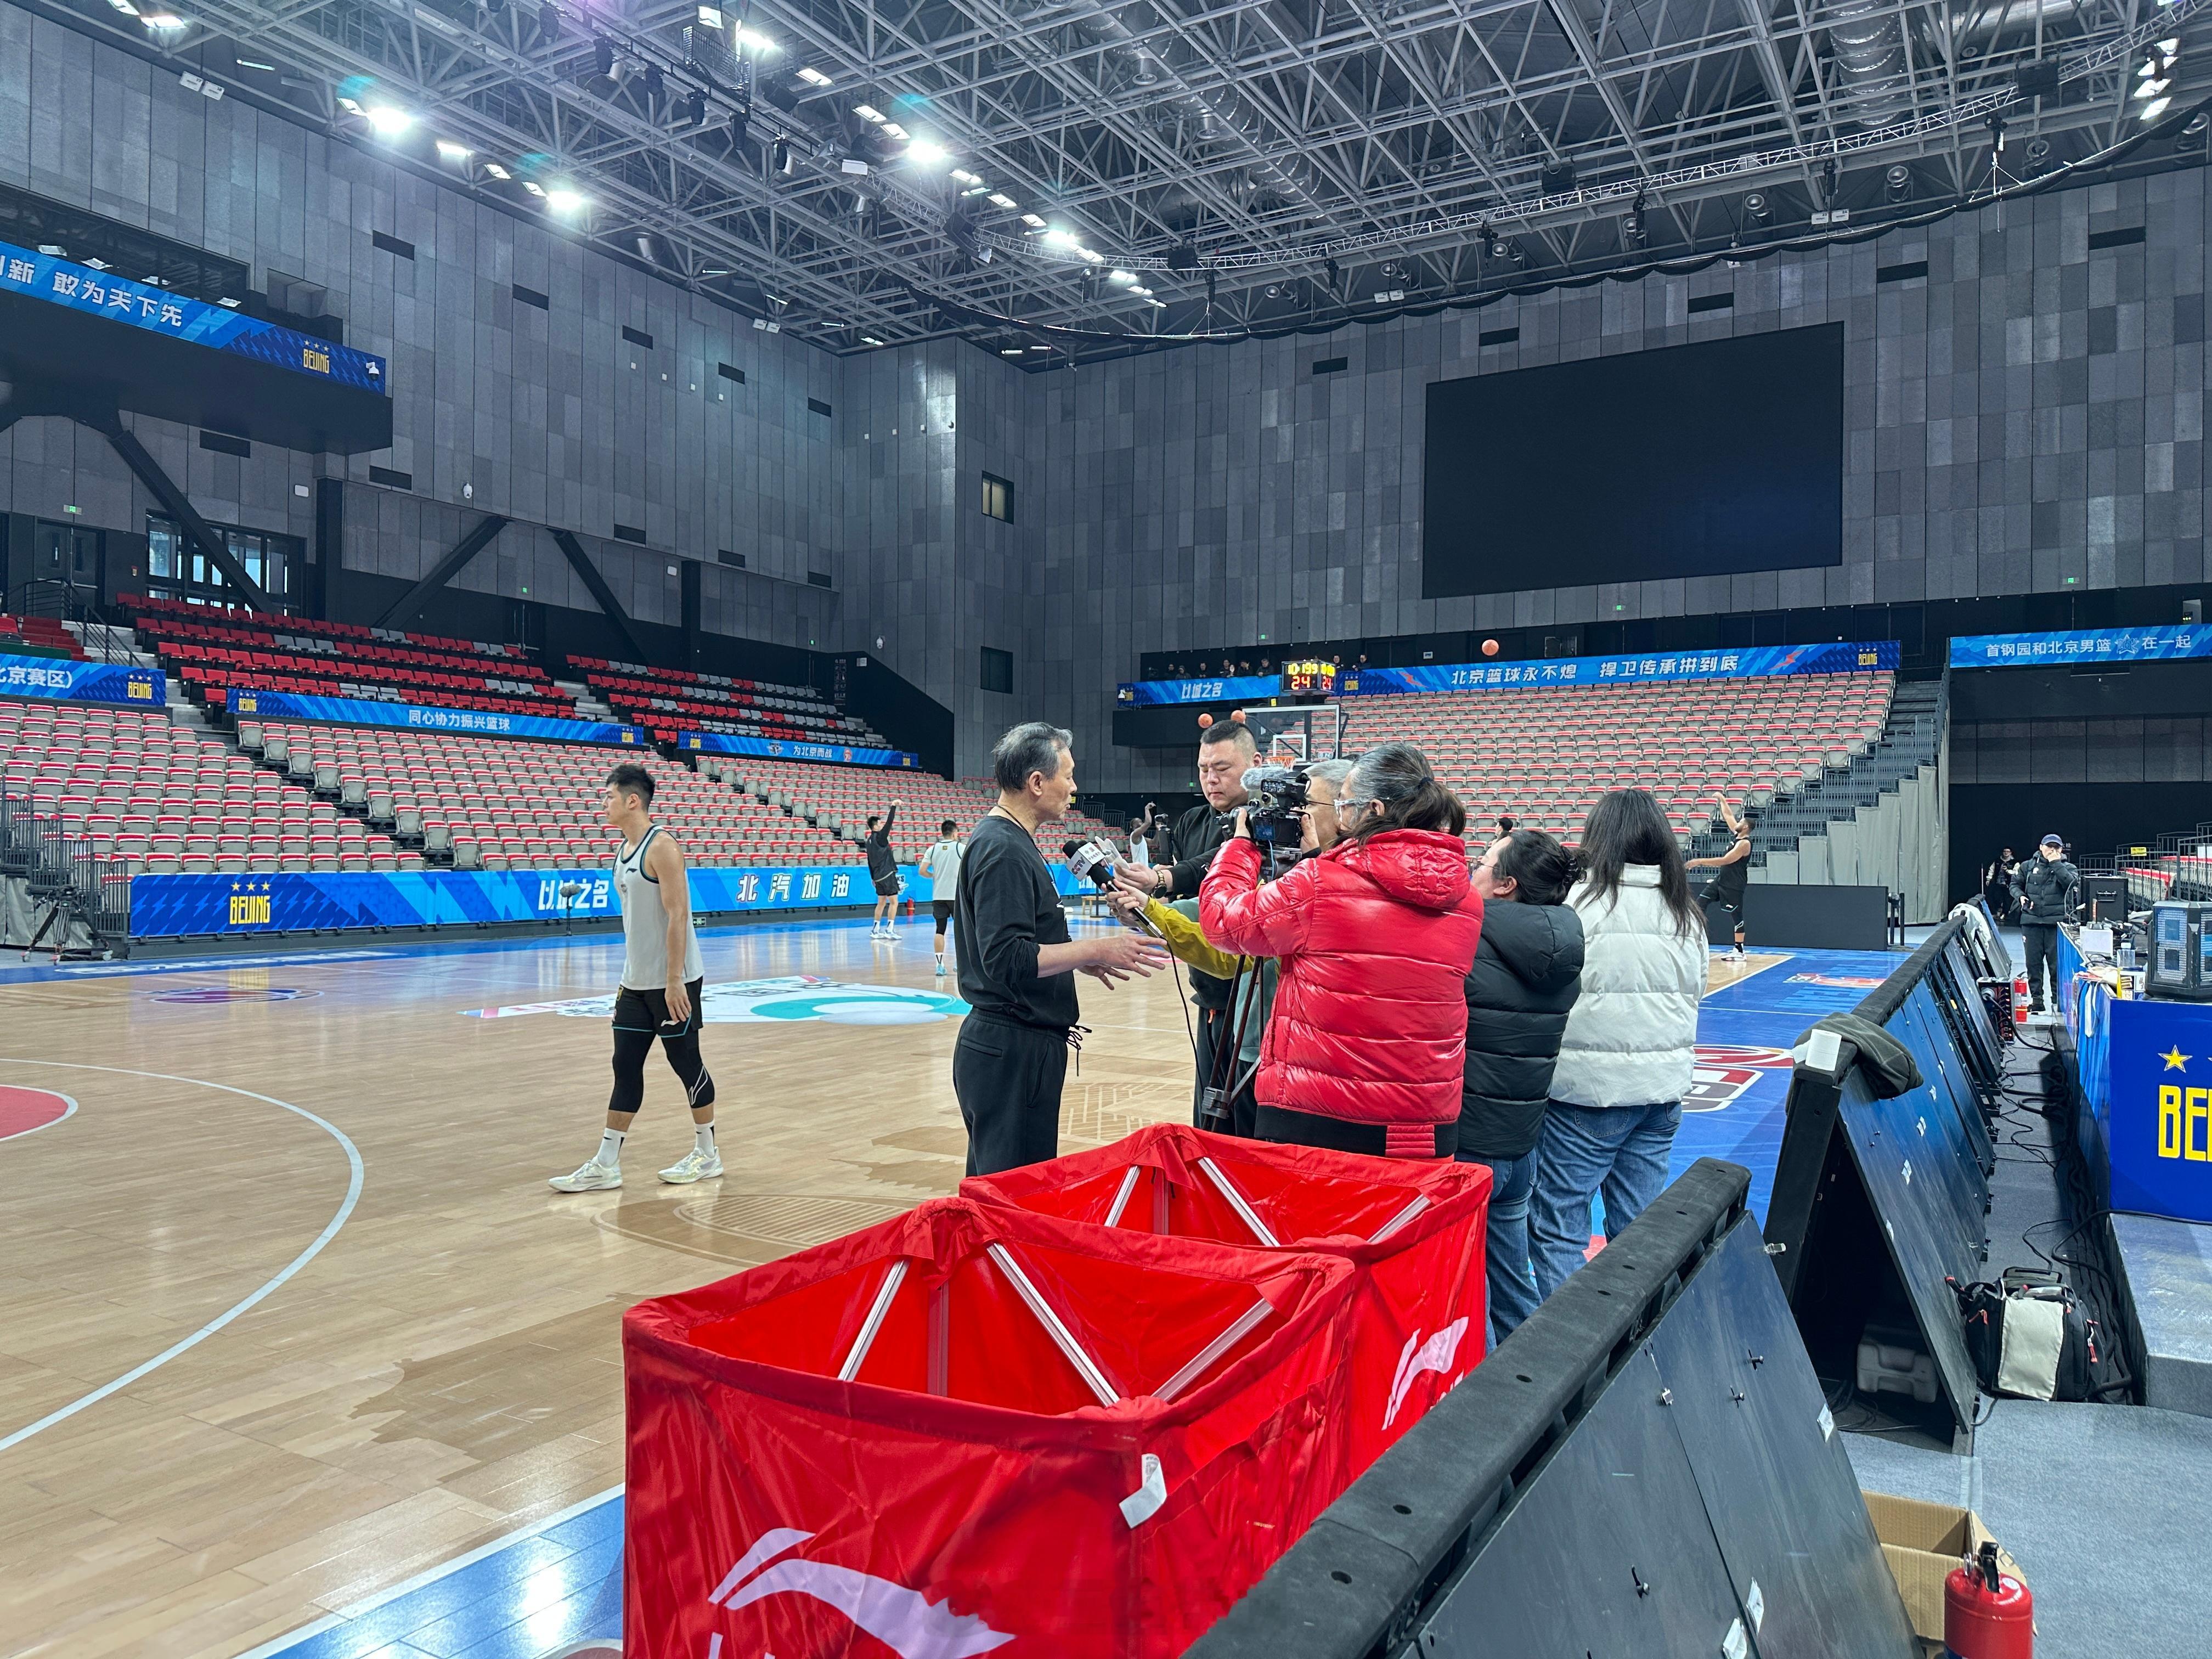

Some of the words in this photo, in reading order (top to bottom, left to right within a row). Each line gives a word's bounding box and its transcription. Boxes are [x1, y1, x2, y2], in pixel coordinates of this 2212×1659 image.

[52, 271, 182, 328] 敢为天下先
[303, 348, 329, 374] BEIJING
[1986, 639, 2112, 657] 首钢园和北京男篮
[2142, 635, 2191, 650] 在一起
[1451, 664, 1577, 685] 北京篮球永不熄
[1599, 655, 1739, 678] 捍卫传承拼到底
[128, 681, 152, 699] BEIJING
[1181, 682, 1223, 699] 以城之名
[1291, 675, 1311, 690] 24
[409, 709, 510, 731] 同心协力振兴篮球
[793, 745, 832, 758] 为北京而战
[1071, 856, 1085, 874] CCTV
[737, 873, 850, 901] 北汽加油
[229, 895, 270, 924] BEIJING
